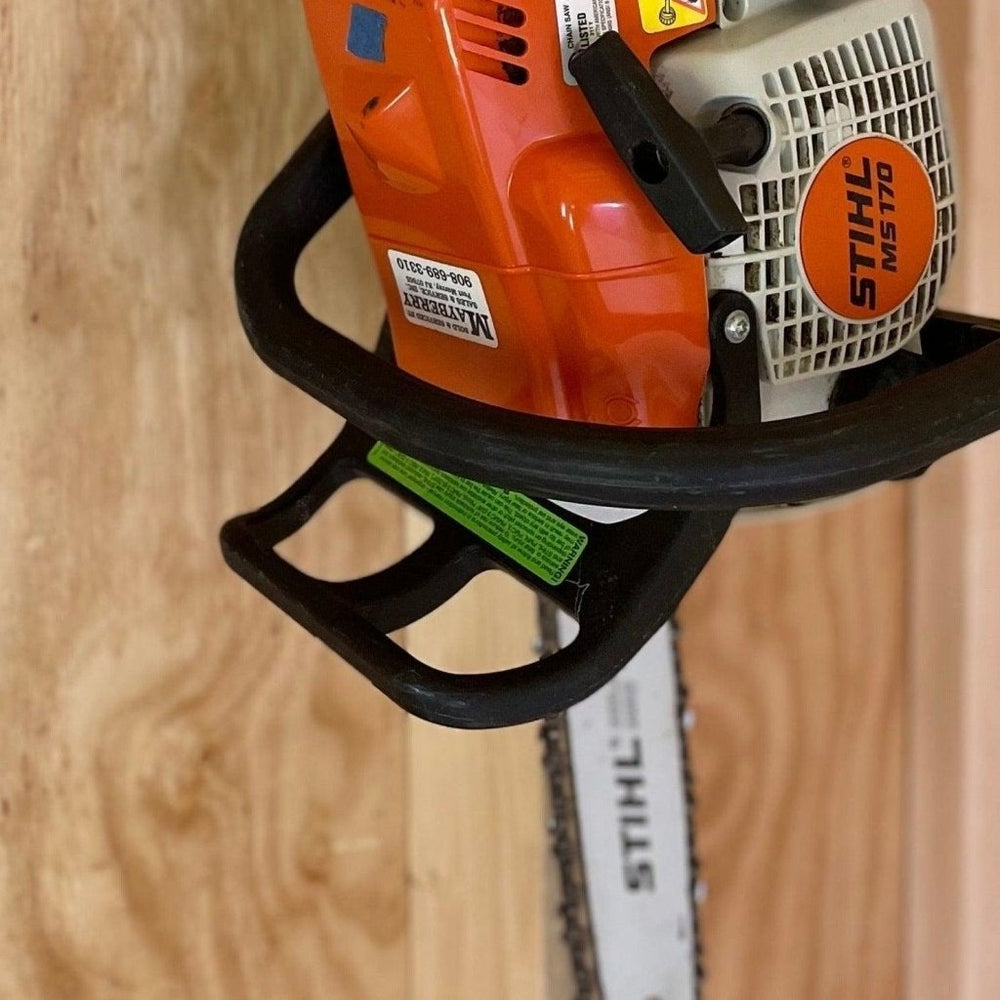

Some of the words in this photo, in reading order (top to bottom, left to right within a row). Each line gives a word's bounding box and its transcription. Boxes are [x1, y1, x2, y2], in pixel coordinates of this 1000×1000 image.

[562, 4, 570, 22] SAW
[576, 12, 590, 47] LISTED
[565, 23, 574, 49] CHAIN
[877, 162, 895, 215] 170
[845, 157, 876, 311] STIHL
[880, 220, 898, 273] MS
[395, 257, 472, 288] 908-689-3310
[614, 737, 655, 892] STIHL
